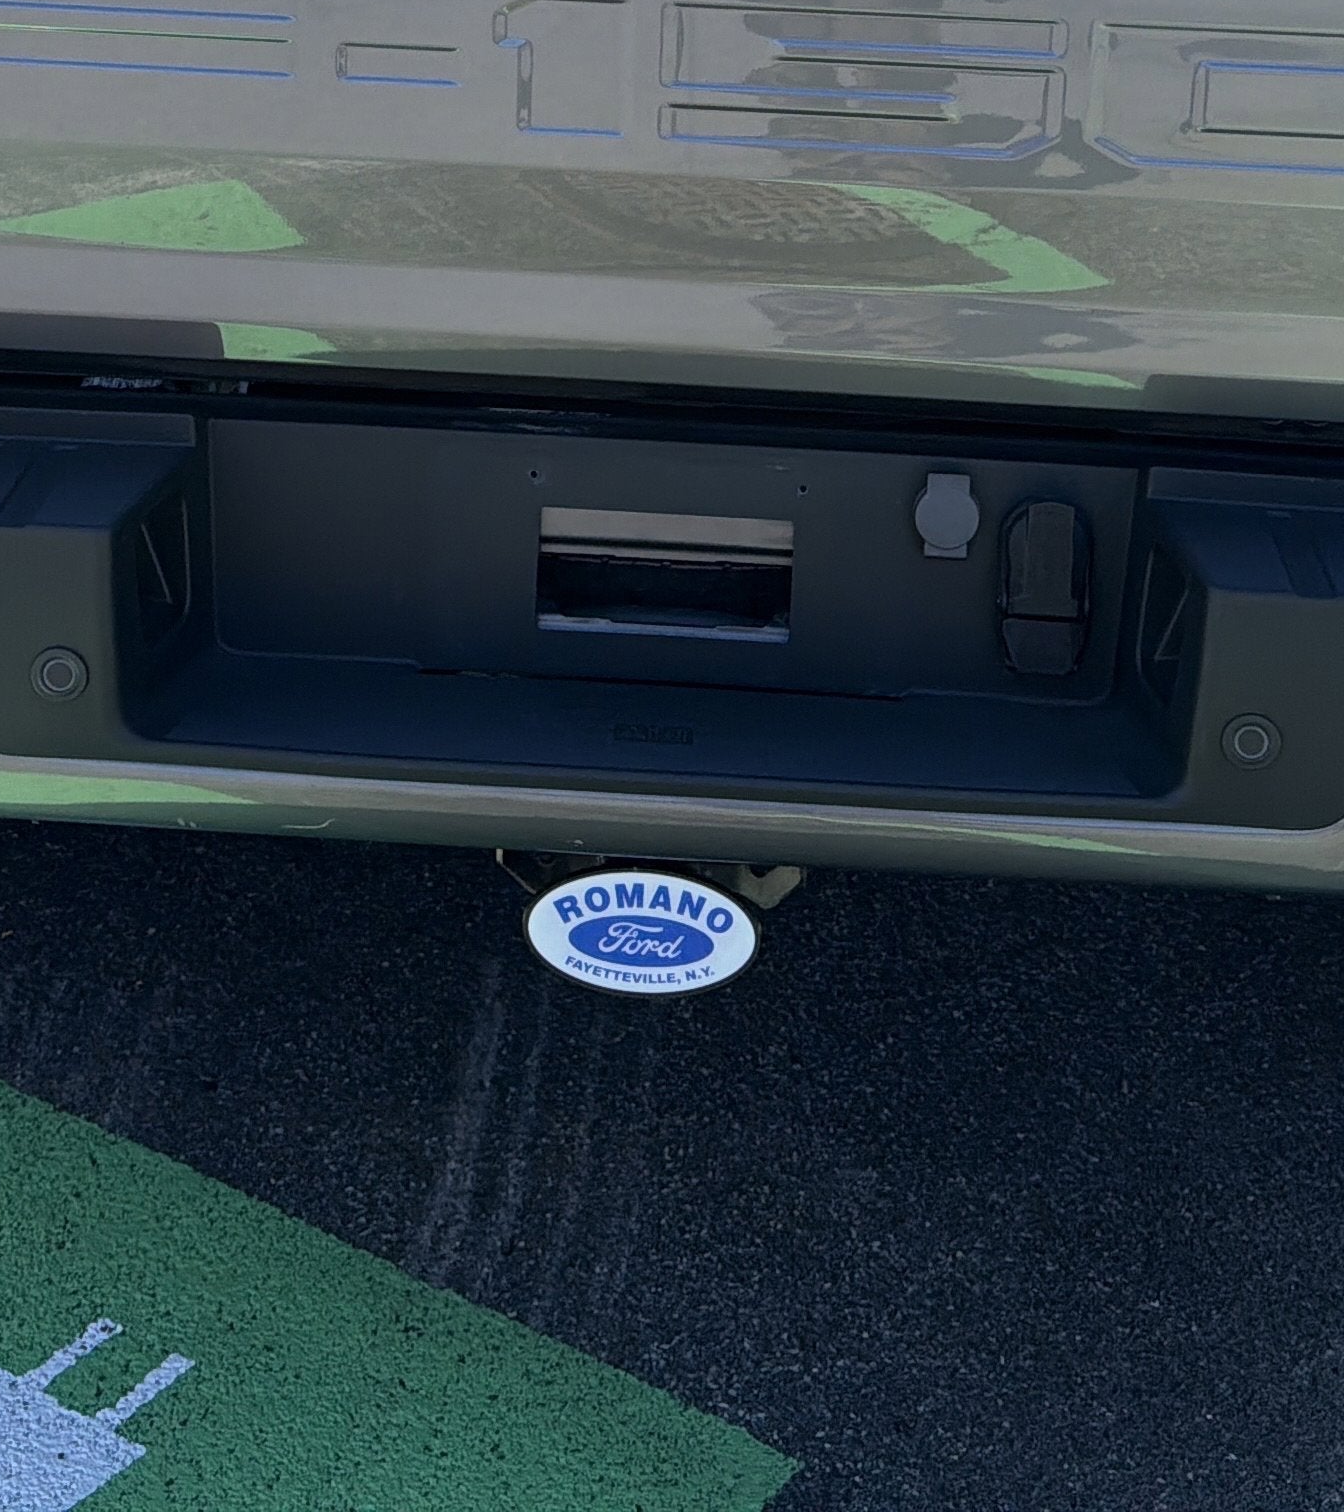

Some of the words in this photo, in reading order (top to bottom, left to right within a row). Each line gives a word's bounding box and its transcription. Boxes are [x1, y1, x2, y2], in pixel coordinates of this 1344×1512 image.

[552, 883, 734, 934] ROMANO
[598, 922, 685, 958] Ford
[564, 955, 682, 986] FAYETTEVILLE,
[684, 965, 715, 983] N.Y.
